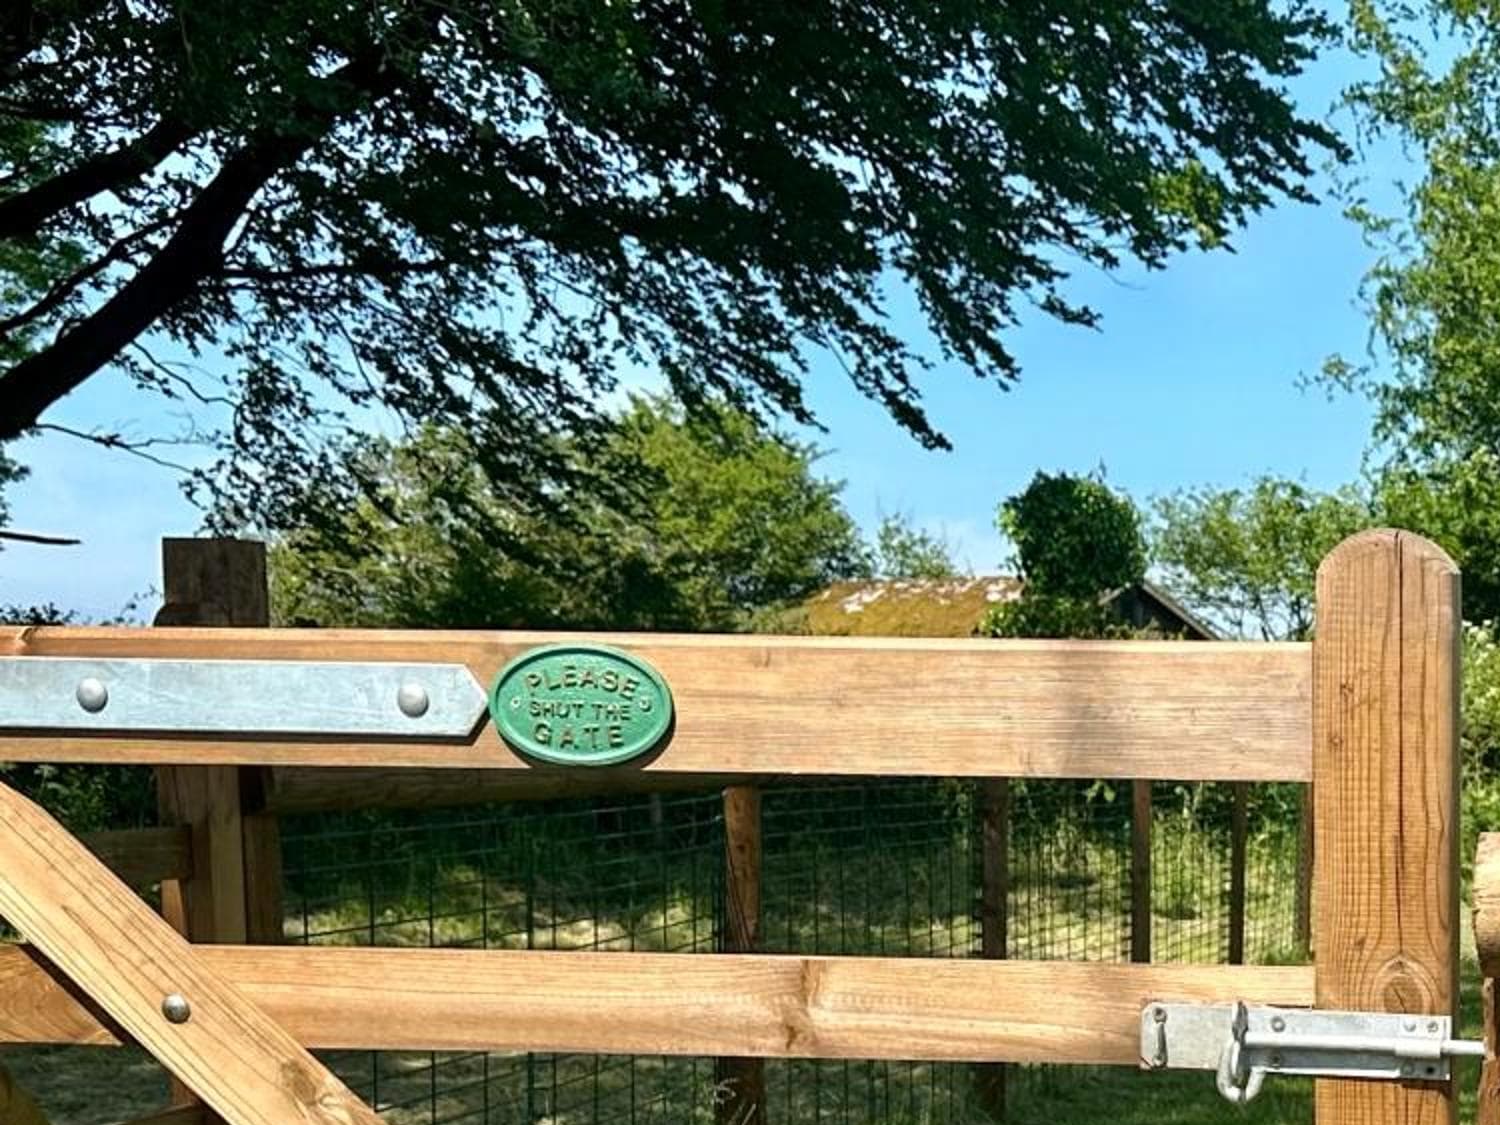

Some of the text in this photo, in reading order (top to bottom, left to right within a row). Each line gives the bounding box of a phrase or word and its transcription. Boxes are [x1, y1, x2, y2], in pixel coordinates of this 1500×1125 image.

[525, 664, 641, 701] PLEASE
[528, 700, 634, 721] SHUT THE
[533, 721, 626, 750] GATE
